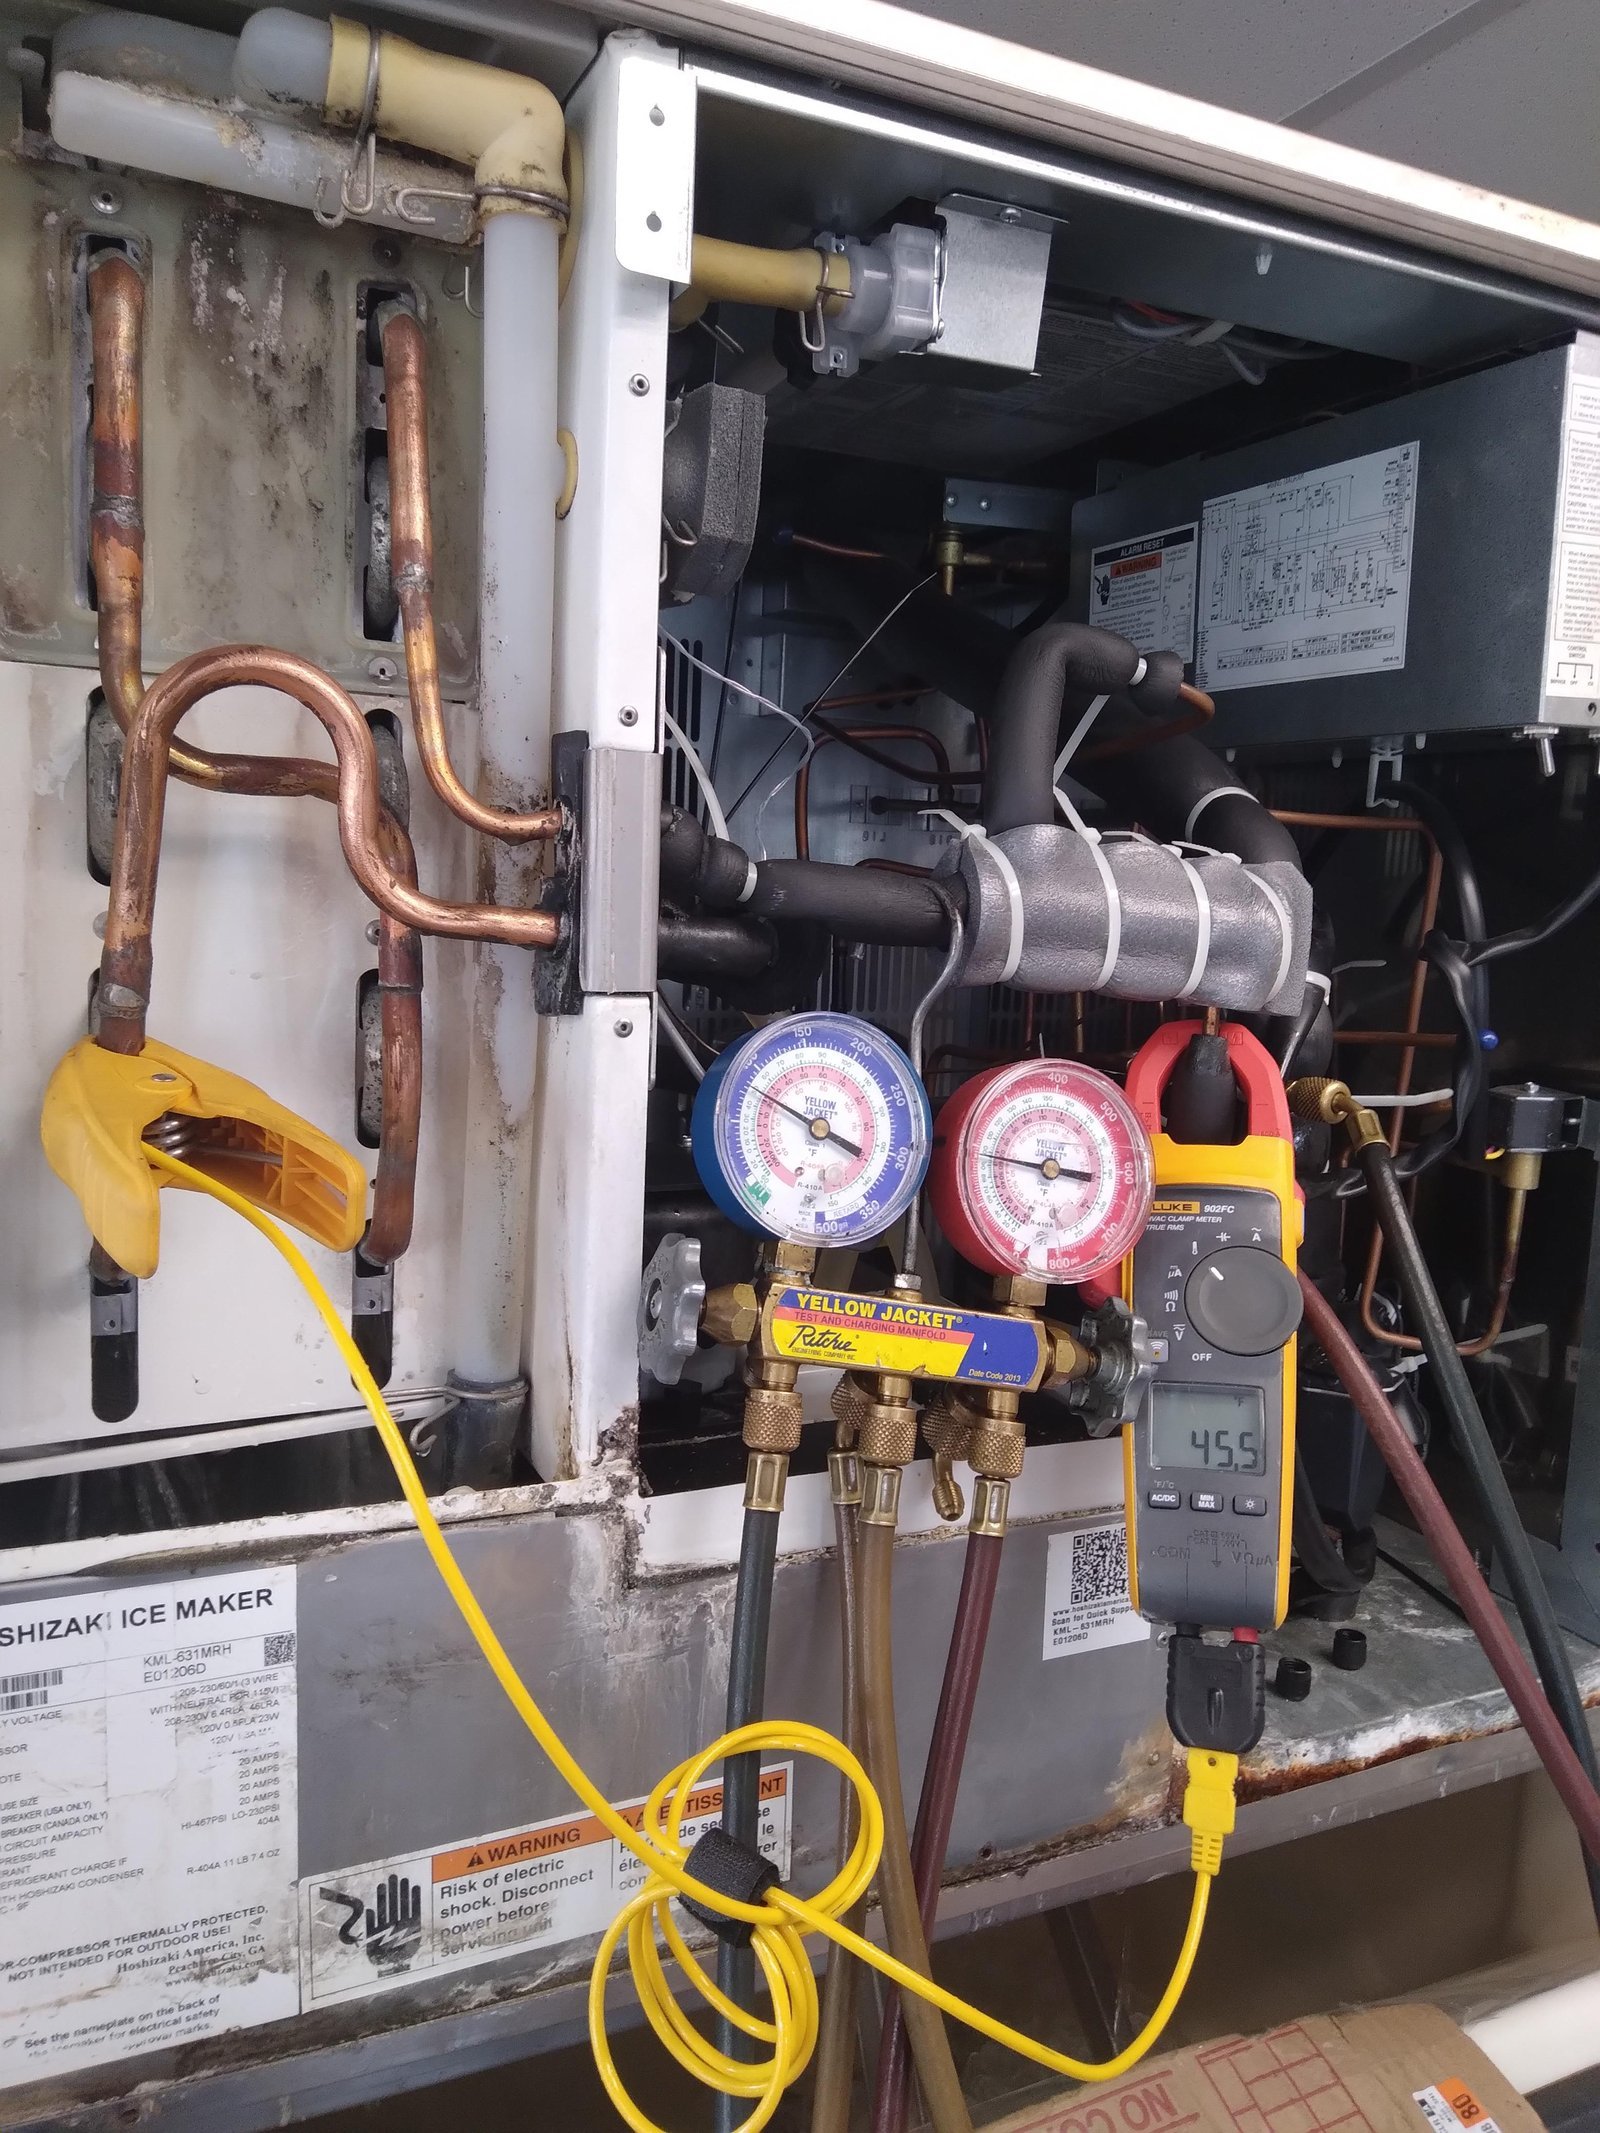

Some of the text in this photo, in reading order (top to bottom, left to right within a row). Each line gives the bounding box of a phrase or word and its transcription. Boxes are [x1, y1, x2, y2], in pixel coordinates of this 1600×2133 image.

[1120, 538, 1165, 557] ALARM RESET
[793, 1026, 812, 1038] 150
[850, 1037, 872, 1056] 200
[1047, 1072, 1068, 1084] 400
[804, 1095, 837, 1109] YELLOW
[890, 1083, 906, 1107] 250
[1100, 1101, 1118, 1122] 500
[1036, 1138, 1065, 1151] YELLOW
[894, 1146, 909, 1171] 300
[1124, 1161, 1134, 1185] 600
[860, 1199, 880, 1220] 350
[1152, 1203, 1235, 1214] LUKE 902FC
[815, 1221, 838, 1233] 500
[1167, 1215, 1195, 1223] CLAMP
[1101, 1222, 1118, 1242] 700
[1048, 1257, 1071, 1270] 800
[797, 1293, 876, 1318] YELLOW
[795, 1311, 946, 1340] TEST AND CHARGING MANIFOLD
[789, 1325, 857, 1352] Ritchie
[1191, 1353, 1213, 1362] OFF
[968, 1368, 1021, 1383] Date Code 2013
[1191, 1429, 1258, 1472] 45.5
[1151, 1493, 1176, 1503] AC/DC
[1198, 1501, 1215, 1509] MAX
[121, 1603, 167, 1629] ICE
[176, 1588, 274, 1621] MAKER
[1052, 1616, 1070, 1626] Scan
[1073, 1613, 1084, 1622] for
[1086, 1609, 1108, 1620] Quick
[1053, 1632, 1088, 1645] E01206D
[143, 1643, 232, 1668] KML-631MRH
[144, 1662, 206, 1684] E01206D
[252, 1672, 279, 1684] WIRE
[150, 1704, 176, 1716] WITH
[179, 1694, 227, 1710] NEUTRAL
[11, 1709, 62, 1726] VOLTAGE
[252, 1751, 280, 1764] AMPS
[239, 1764, 280, 1779] 20 AMPS
[239, 1777, 280, 1792] 20 AMPS
[20, 1796, 39, 1808] SIZE
[239, 1790, 280, 1806] 20 AMPS
[1, 1800, 92, 1825] BREAKER (USA ONLY)
[231, 1803, 280, 1821] LO-230PSI
[257, 1815, 280, 1826] 404A
[0, 1811, 109, 1838] BREAKER (CANADA ONLY)
[3, 1825, 104, 1852] CIRCUIT AMPACITY
[488, 1828, 581, 1862] WARNING
[0, 1848, 56, 1865] PRESSURE
[71, 1859, 116, 1876] CHARGE
[118, 1857, 128, 1866] IF
[186, 1861, 221, 1875] R-404A
[237, 1855, 249, 1865] LB
[266, 1848, 280, 1858] OZ
[19, 1867, 144, 1900] HOSHIZAKI CONDENSER
[440, 1859, 565, 1899] Risk of electric
[440, 1895, 496, 1919] shock.
[502, 1868, 594, 1903] Disconnect
[114, 1922, 189, 1947] THERMALLY
[192, 1905, 269, 1929] PROTECTED,
[440, 1901, 550, 1940] power before
[117, 1950, 179, 1973] Hoshizaki
[243, 1933, 265, 1946] Inc.
[248, 1945, 266, 1956] GA
[440, 1929, 519, 1958] servicing
[8, 1968, 35, 1982] NOT
[39, 1954, 103, 1976] INTENDED
[107, 1947, 133, 1961] FOR
[137, 1932, 199, 1953] OUTDOOR
[25, 2037, 47, 2049] See
[51, 2031, 70, 2042] the
[73, 2016, 135, 2038] nameplate
[138, 2012, 153, 2022] on
[156, 2006, 175, 2017] the
[178, 1999, 205, 2012] back
[208, 1994, 220, 2004] of
[110, 2008, 220, 2040] for electrical safety
